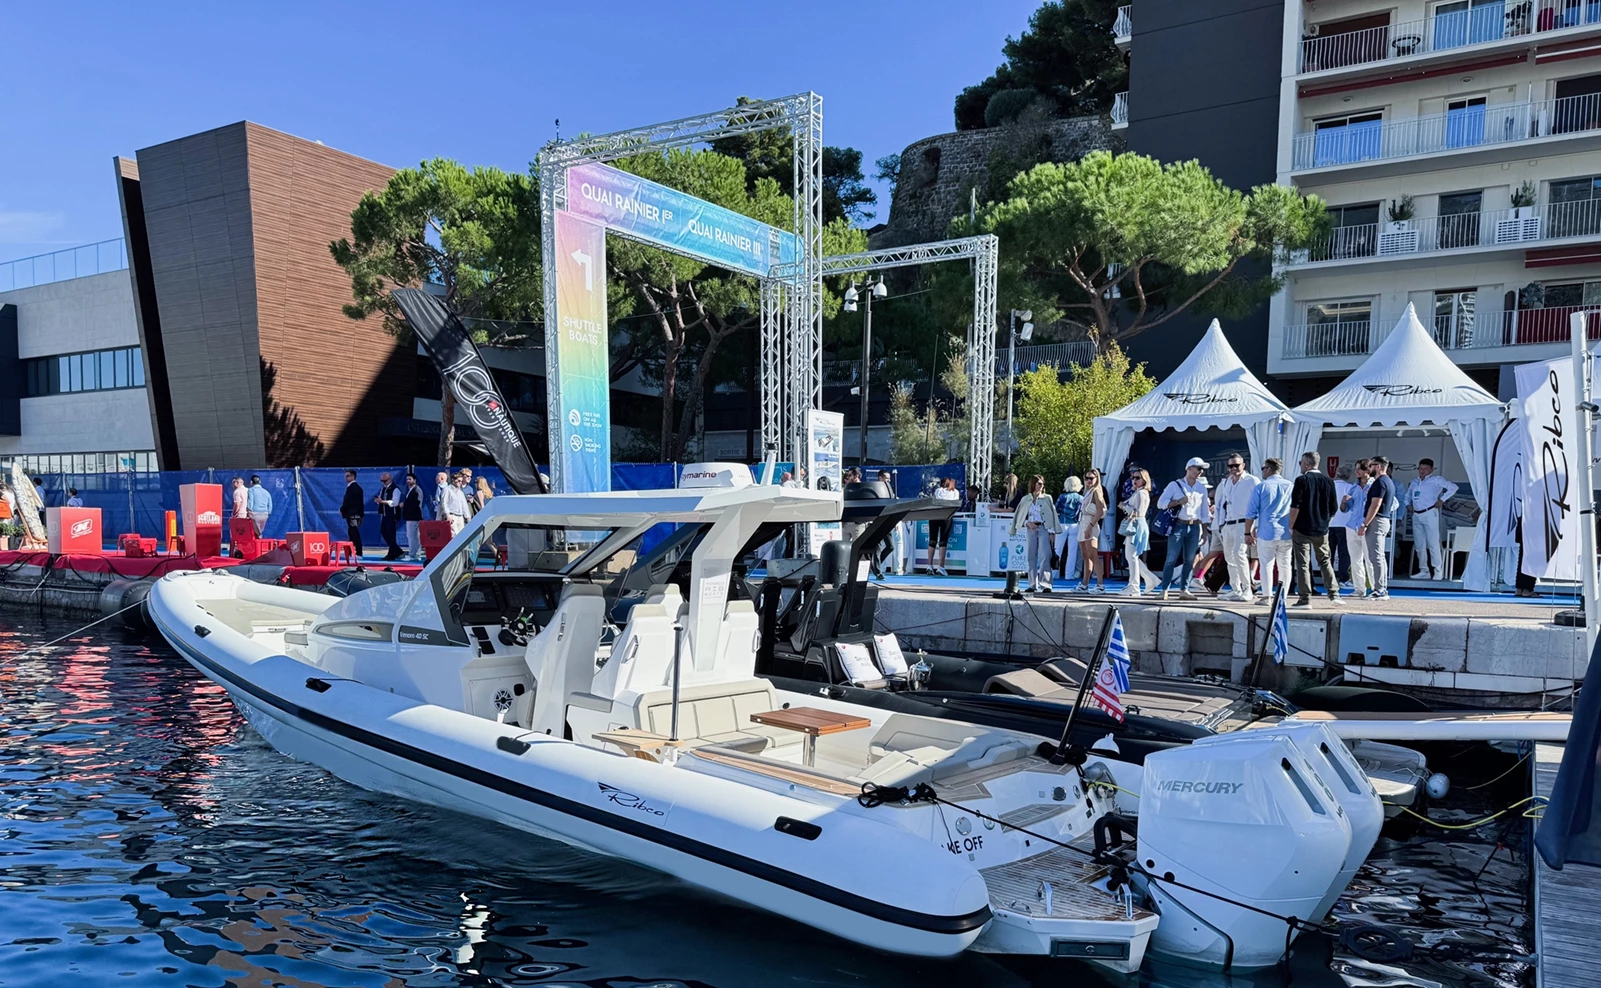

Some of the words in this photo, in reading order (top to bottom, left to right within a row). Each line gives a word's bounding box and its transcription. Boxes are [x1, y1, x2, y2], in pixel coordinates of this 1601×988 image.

[581, 182, 612, 205] QUAI
[615, 194, 660, 222] RAINIER
[688, 219, 713, 237] QUAI
[715, 230, 751, 252] RAINIER
[753, 240, 761, 255] III
[563, 316, 602, 334] SHUTTLE
[569, 329, 599, 346] BOATS
[1163, 393, 1238, 405] Ribco
[1363, 384, 1443, 397] Ribco
[493, 407, 522, 448] NAUTIQUE
[1543, 369, 1570, 560] Ribco
[309, 542, 325, 552] 100
[399, 631, 415, 639] Venom
[1157, 780, 1244, 794] MERCURY
[598, 781, 664, 816] Ribco
[964, 835, 983, 851] OFF
